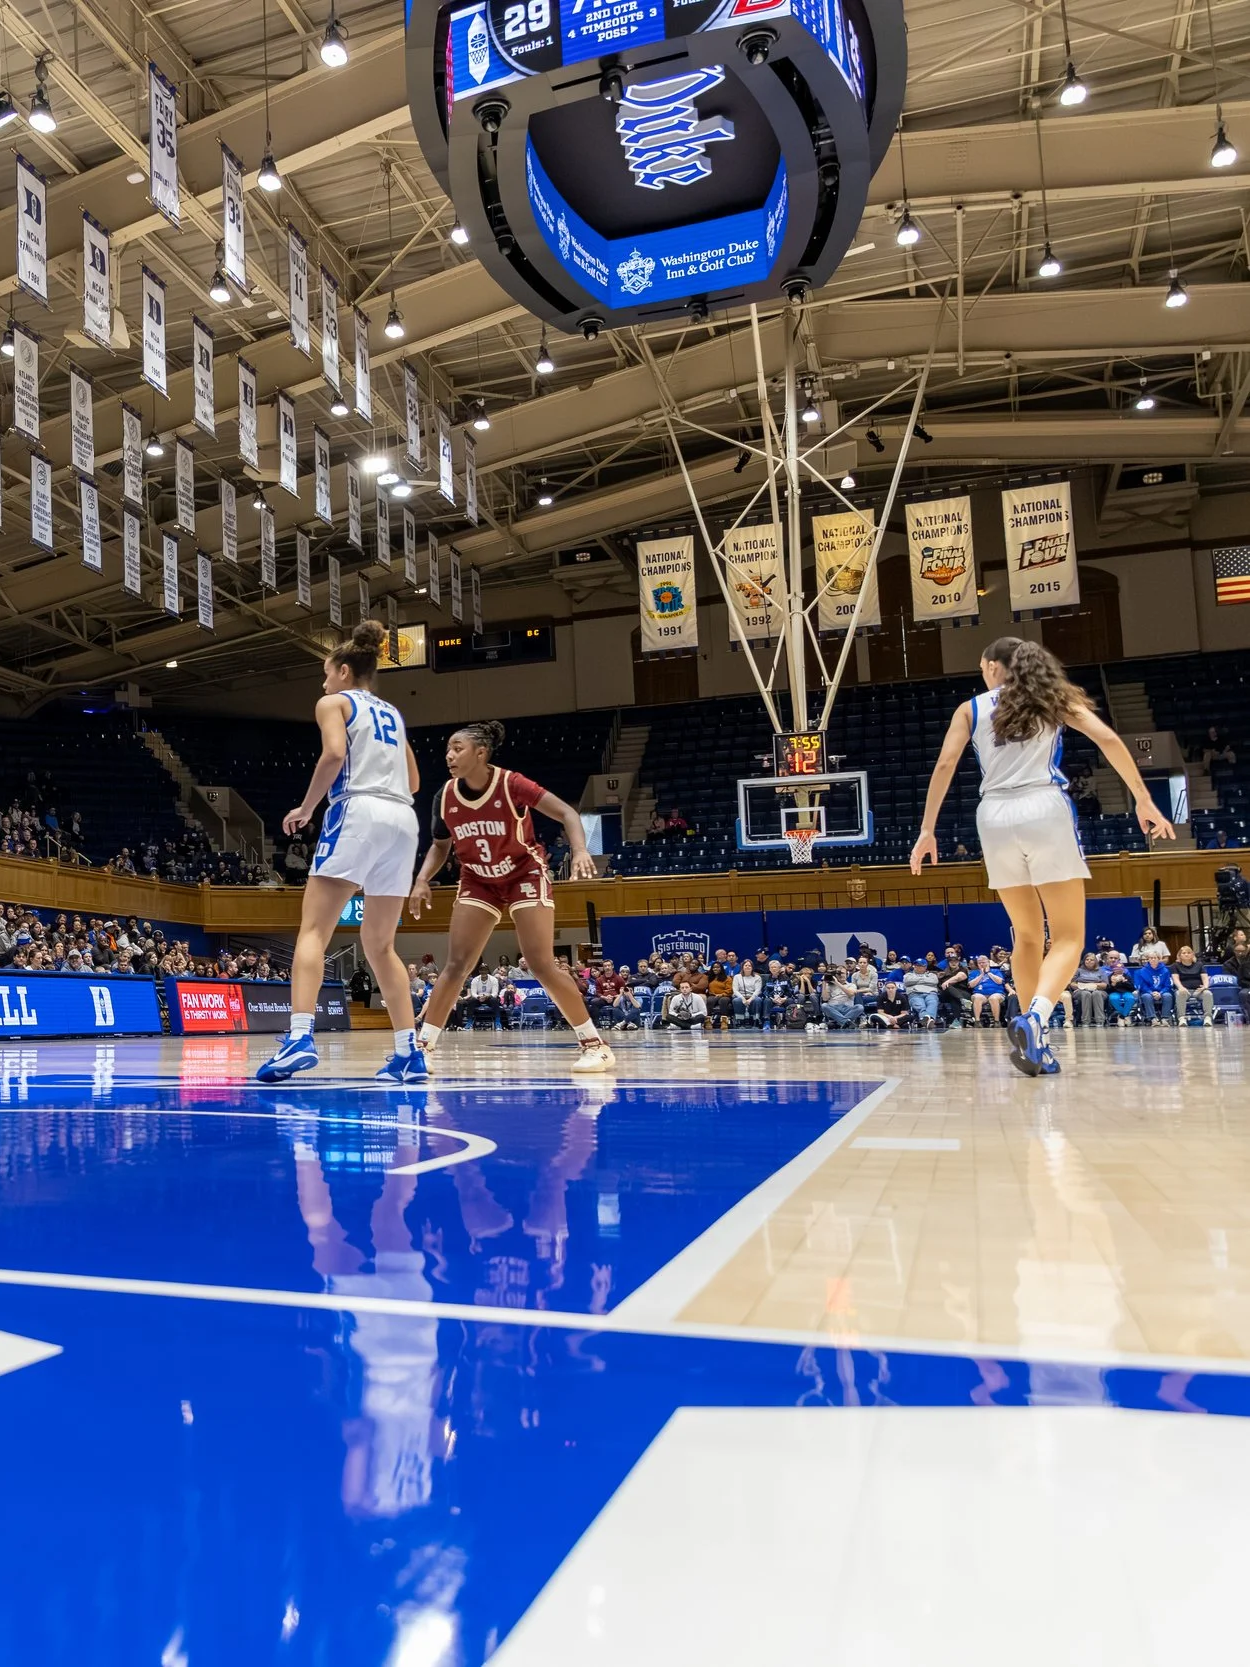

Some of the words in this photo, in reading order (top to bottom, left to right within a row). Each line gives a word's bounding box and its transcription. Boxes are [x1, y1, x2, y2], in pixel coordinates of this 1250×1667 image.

[504, 0, 551, 41] 29
[586, 9, 610, 22] 2ND
[614, 2, 638, 16] QTR
[567, 30, 576, 39] 4
[581, 11, 644, 36] TIMEOUTS
[649, 8, 658, 18] 3
[597, 26, 628, 43] POSS
[511, 40, 545, 57] Fouls:
[546, 36, 554, 46] 1
[156, 118, 175, 158] 35
[27, 229, 40, 246] NCAA
[19, 240, 33, 258] FINAL
[570, 236, 596, 265] Washington
[660, 247, 726, 267] Washington
[728, 239, 759, 253] Duke
[666, 267, 685, 280] Inn
[687, 264, 698, 276] &
[699, 258, 724, 273] Golf
[726, 251, 755, 267] Club
[92, 280, 105, 296] NCAA
[294, 273, 303, 302] 11
[1012, 498, 1062, 515] NATIONAL
[916, 511, 962, 528] NATIONAL
[1008, 510, 1070, 528] CHAMPIONS
[822, 524, 867, 539] NATIONAL
[912, 523, 969, 541] CHAMPIONS
[733, 537, 775, 552] NATIONAL
[1035, 535, 1067, 551] FINAL
[646, 550, 686, 564] NATIONAL
[933, 548, 964, 559] FINAL
[1022, 545, 1067, 567] FOUR
[641, 562, 692, 577] CHAMPIONS
[1029, 581, 1061, 595] 2015
[931, 591, 961, 605] 2010
[835, 603, 863, 616] 200
[745, 615, 772, 626] 1992
[439, 638, 462, 647] DUKE
[527, 629, 540, 637] BC
[657, 625, 682, 637] 1991
[369, 706, 398, 747] 12
[789, 736, 820, 750] 7:55
[1140, 740, 1151, 750] 10
[795, 750, 816, 773] 12
[454, 820, 506, 840] BOSTON
[475, 838, 492, 863] 3
[465, 856, 517, 878] COLLEGE
[657, 941, 705, 954] SISTERHOOD
[1213, 975, 1234, 985] DUKE
[89, 986, 115, 1026] D
[182, 993, 201, 1008] FAN
[201, 993, 226, 1009] WORK
[248, 1002, 258, 1012] Over
[263, 1003, 274, 1012] Hotel
[184, 1011, 190, 1019] IS
[190, 1011, 211, 1020] THIRSTY
[211, 1011, 228, 1020] WORK
